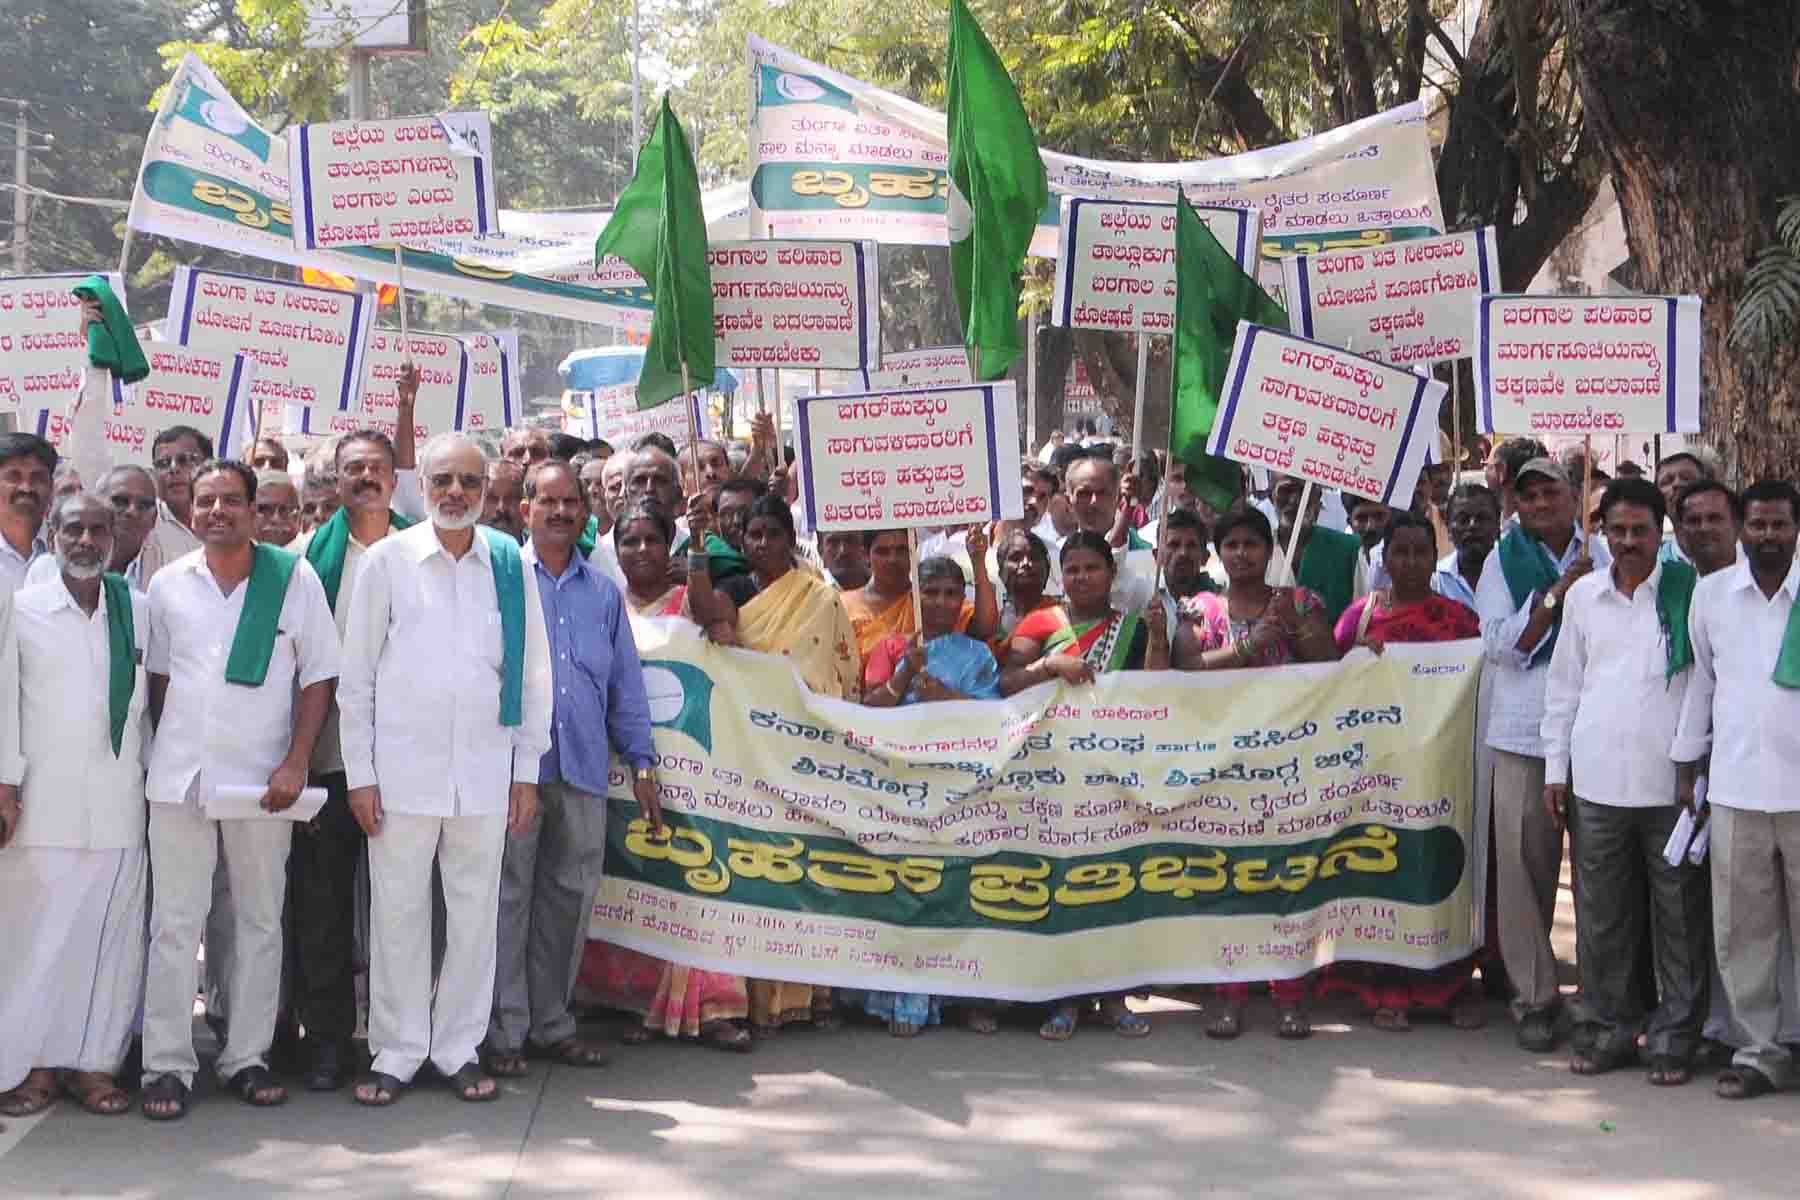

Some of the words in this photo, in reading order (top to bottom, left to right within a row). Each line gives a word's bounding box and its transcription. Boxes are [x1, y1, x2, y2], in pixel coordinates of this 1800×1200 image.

[331, 124, 384, 152] ಜಿಲ್ಲೆಯ
[328, 156, 458, 183] ತಾಲ್ಲೂಕುಗಳನ್ನು
[332, 190, 398, 209] ಬರಗಾಲ
[408, 187, 453, 205] ಎಂದು
[318, 218, 379, 246] ಘೋಷಣೆ
[390, 213, 473, 237] ಮಾಡಬೇಕು
[1100, 207, 1151, 236] ಜಿಲ್ಲೆಯ
[1285, 210, 1349, 227] ಮಾಡಲು
[1357, 205, 1432, 225] ಒತ್ತಾಯಿಸಿ
[777, 248, 842, 265] ಪರಿಹಾರ
[1316, 256, 1364, 273] ತುಂಗಾ
[1373, 250, 1396, 267] ಏತ
[1405, 239, 1464, 262] ನೀರಾವರಿ
[202, 281, 247, 301] ತುಂಗಾ
[254, 288, 276, 304] ಏತ
[283, 292, 340, 314] ನೀರಾವರಿ
[1092, 277, 1153, 295] ಬರಗಾಲ
[1317, 280, 1377, 307] ಯೋಜನೆ
[1384, 269, 1478, 298] ಪೂರ್ಣಗೊಳಿಸಿ
[196, 306, 253, 332] ಯೋಜನೆ
[259, 320, 345, 345] ಪೂರ್ಣಗೊಳಿಸಿ
[713, 308, 762, 340] ಕ್ಷಣವೇ
[773, 309, 853, 331] ಬದಲಾವಣೆ
[1074, 301, 1133, 326] ಘೋಷಣೆ
[1369, 306, 1424, 339] ತಕ್ಷಣವೇ
[1503, 306, 1573, 325] ಬರಗಾಲ
[1584, 305, 1653, 323] ಪರಿಹಾರ
[731, 339, 820, 362] ಮಾಡಬೇಕು
[1391, 335, 1460, 362] ಹರಿಸಬೇಕು
[1497, 341, 1661, 373] ಮಾರ್ಗಸೂಚಿಯನ್ನು
[24, 366, 80, 391] ಮಾಡಬೇ
[1495, 372, 1564, 405] ತಕ್ಷಣವೇ
[1575, 372, 1661, 394] ಬದಲಾವಣೆ
[146, 389, 213, 415] ಕಾಮಗಾರಿ
[1260, 376, 1398, 430] ಸಾಗುವಳಿದಾರರಿಗೆ
[1531, 406, 1624, 429] ಮಾಡಬೇಕು
[827, 422, 973, 455] ಸಾಗುವಳಿದಾರರಿಗೆ
[1263, 412, 1307, 443] ತಕ್ಷಣ
[1316, 426, 1376, 465] ಹಕ್ಕುಪತ್ರ
[841, 468, 886, 496] ತಕ್ಷಣ
[896, 464, 965, 494] ಹಕ್ಕುಪತ್ರ
[1234, 439, 1296, 468] ವಿತರಣೆ
[1302, 453, 1382, 496] ಮಾಡಬೇಕು
[824, 497, 882, 522] ವಿತರಣೆ
[893, 491, 986, 518] ಮಾಡಬೇಕು
[1068, 732, 1146, 755] ಸಂಘ
[1233, 720, 1319, 750] ಹಸಿರು
[1336, 705, 1402, 732] ಸೇನೆ
[656, 754, 704, 776] ಂಗಾ
[1018, 796, 1063, 824] ತಕ್ಷಣ
[1250, 788, 1308, 818] ರೈತರ
[1319, 773, 1403, 802] ಸಂಪೂರ್ಣ
[791, 756, 929, 808] ಶಿವಮೊಗ್ಗ
[1165, 757, 1300, 788] ಶಿವಮೊಗ್ಗ
[704, 789, 773, 818] ಮಾಡಲು
[954, 823, 1029, 846] ಪರಿಹಾರ
[1277, 805, 1353, 836] ಮಾಡಲು
[624, 818, 947, 894] ಬೃಹತ್
[969, 824, 1398, 924] ಪ್ರತಿಭಟನೆ
